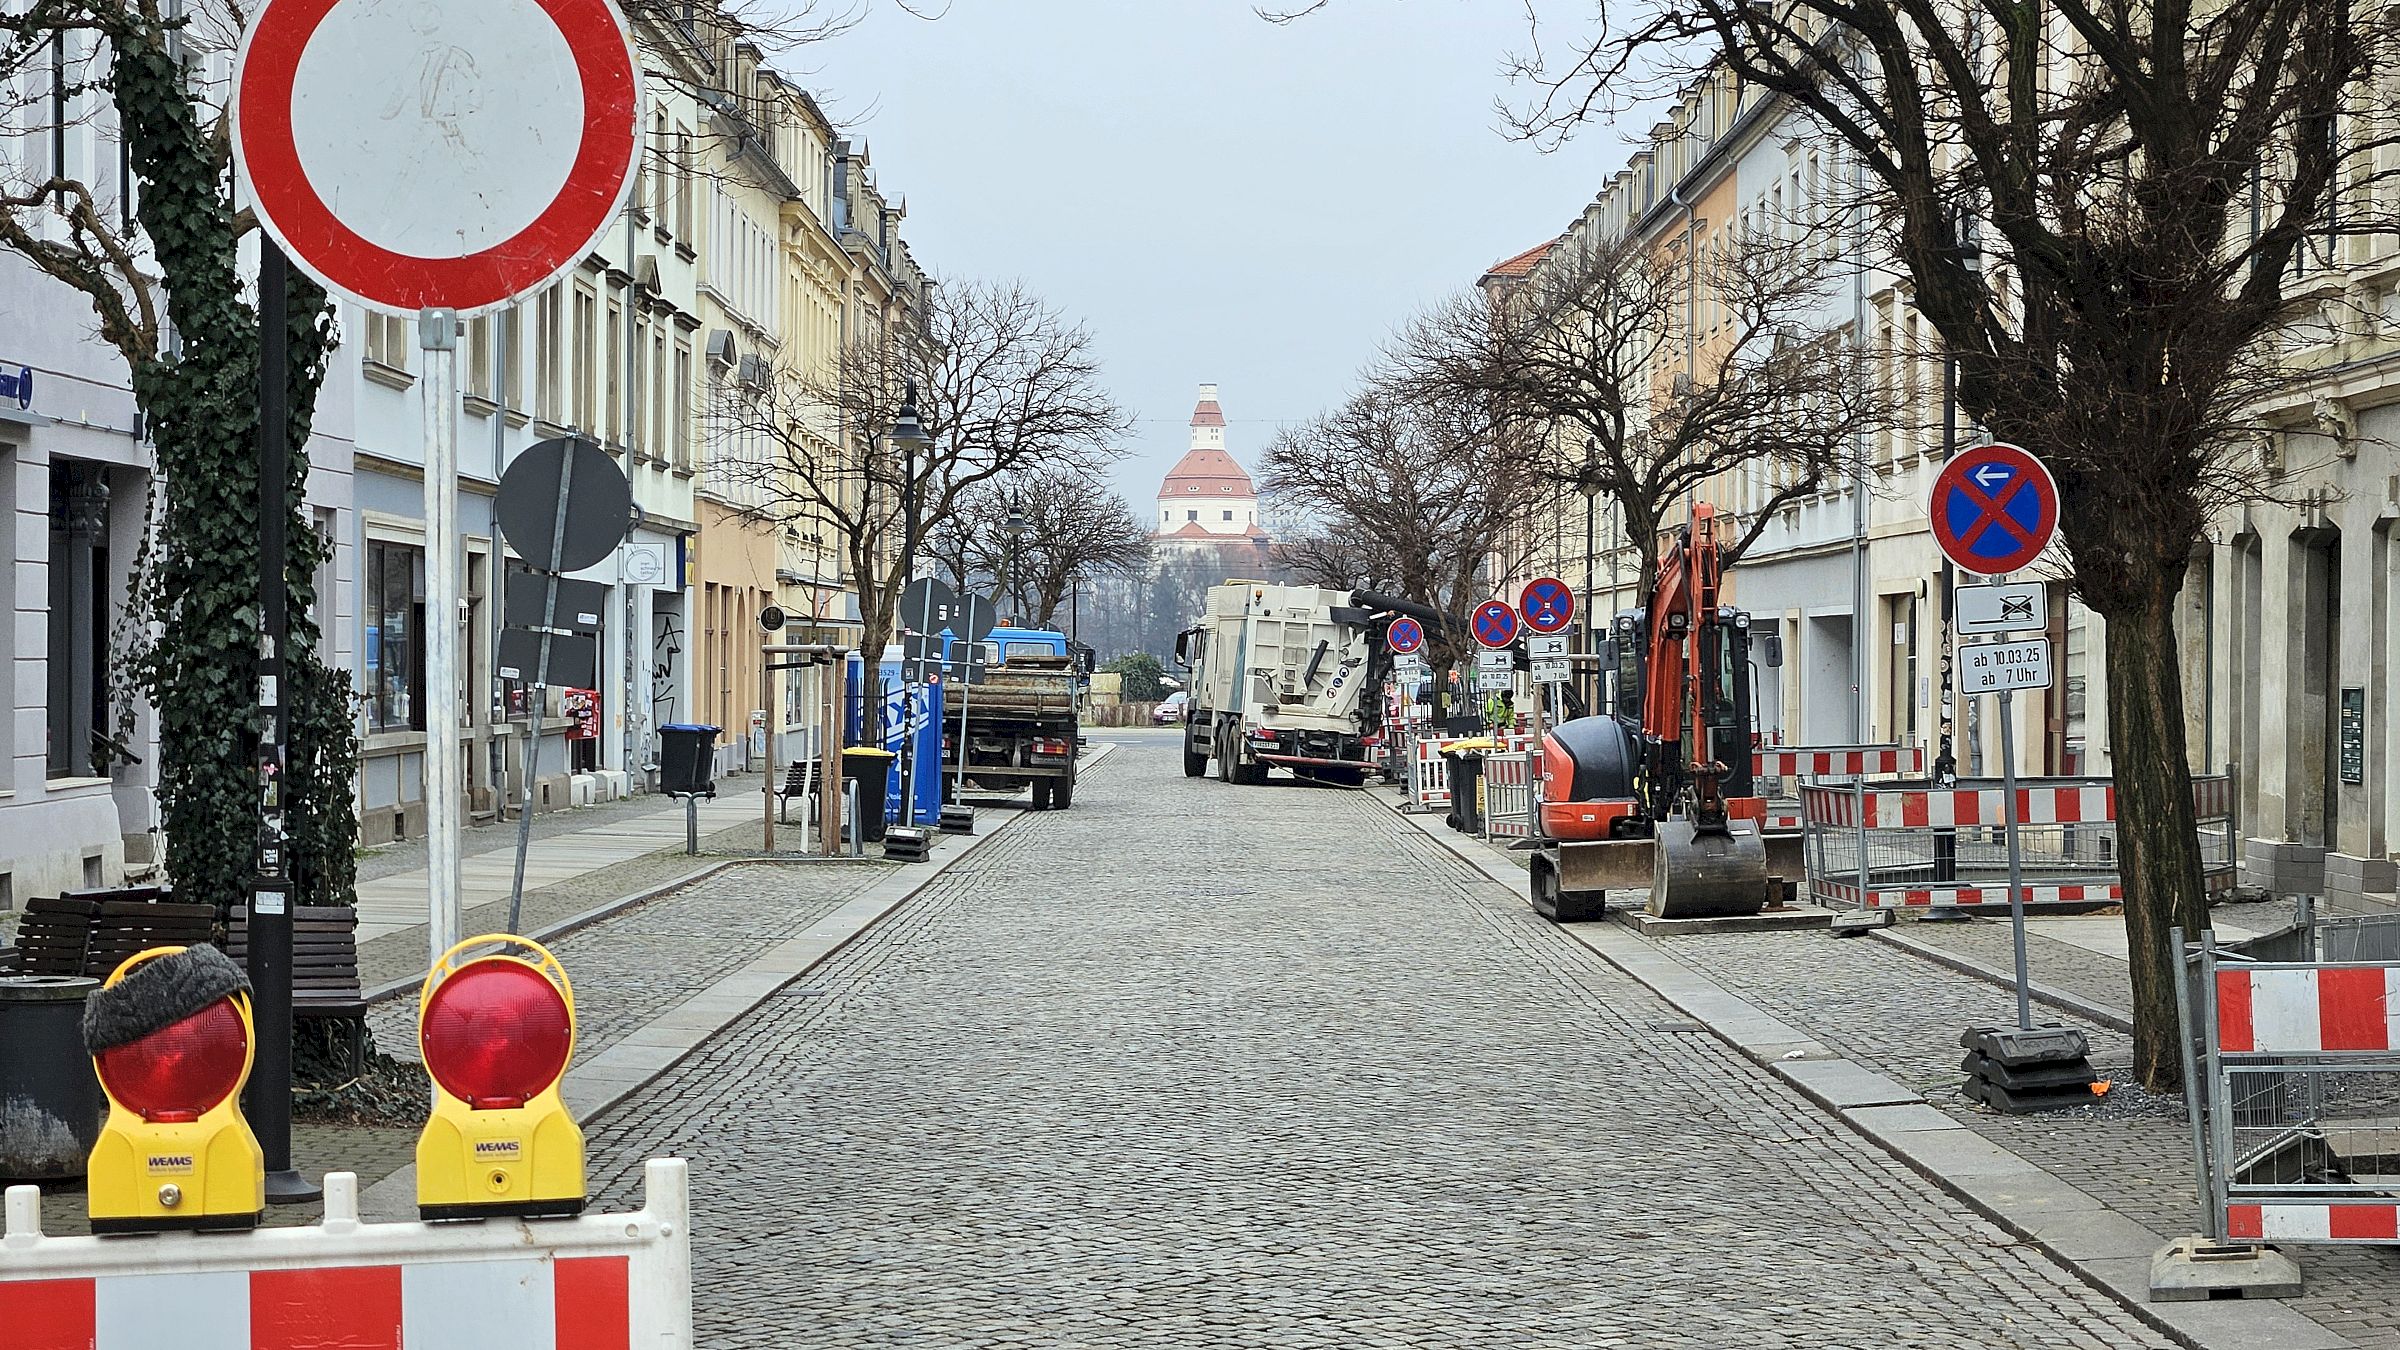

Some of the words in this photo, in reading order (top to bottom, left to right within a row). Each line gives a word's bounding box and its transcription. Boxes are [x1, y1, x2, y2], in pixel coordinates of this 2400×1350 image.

[1974, 652, 1988, 667] ab
[1993, 647, 2040, 666] 10.03.25
[1981, 670, 1996, 686] ab
[2006, 669, 2013, 684] 7
[2016, 667, 2038, 682] Uhr
[476, 1141, 519, 1152] WEMAS
[148, 1156, 193, 1167] WEMAS
